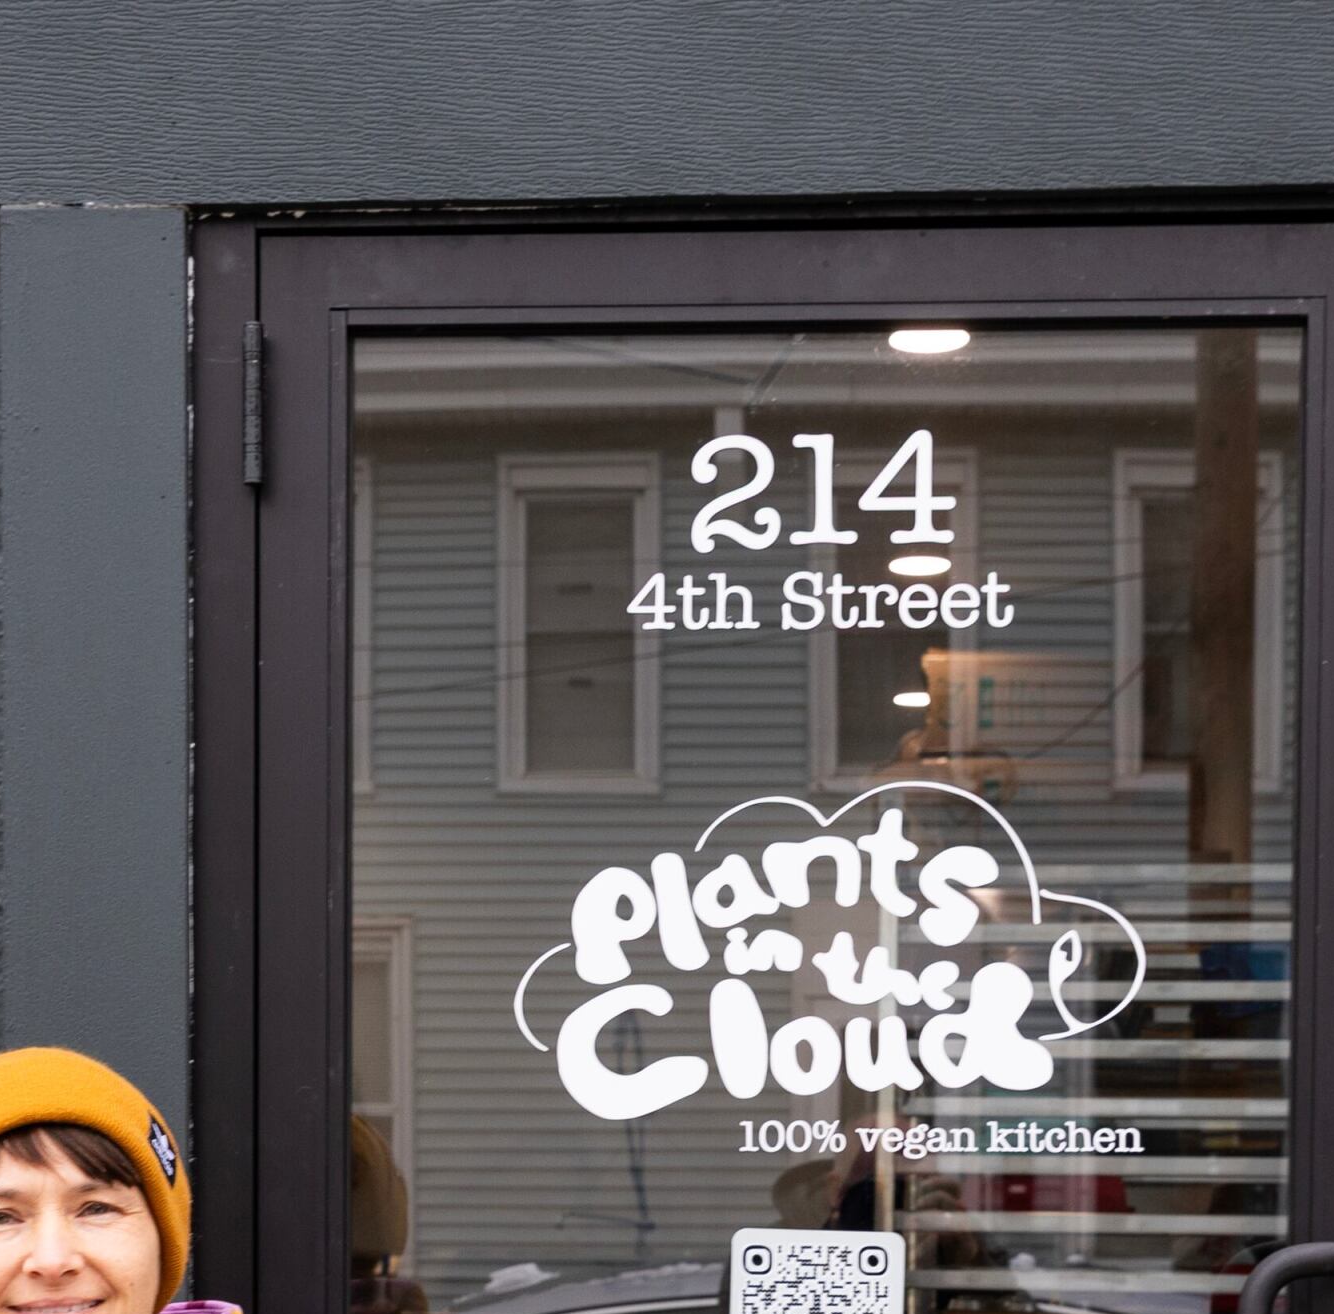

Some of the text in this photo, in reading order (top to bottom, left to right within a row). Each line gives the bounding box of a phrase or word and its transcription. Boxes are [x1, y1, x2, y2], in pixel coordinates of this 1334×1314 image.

[691, 429, 957, 554] 214
[626, 570, 1015, 631] 4th Street
[724, 927, 959, 1011] in the
[557, 962, 1054, 1120] Cloud
[738, 1119, 1145, 1160] 100% vegan kitchen
